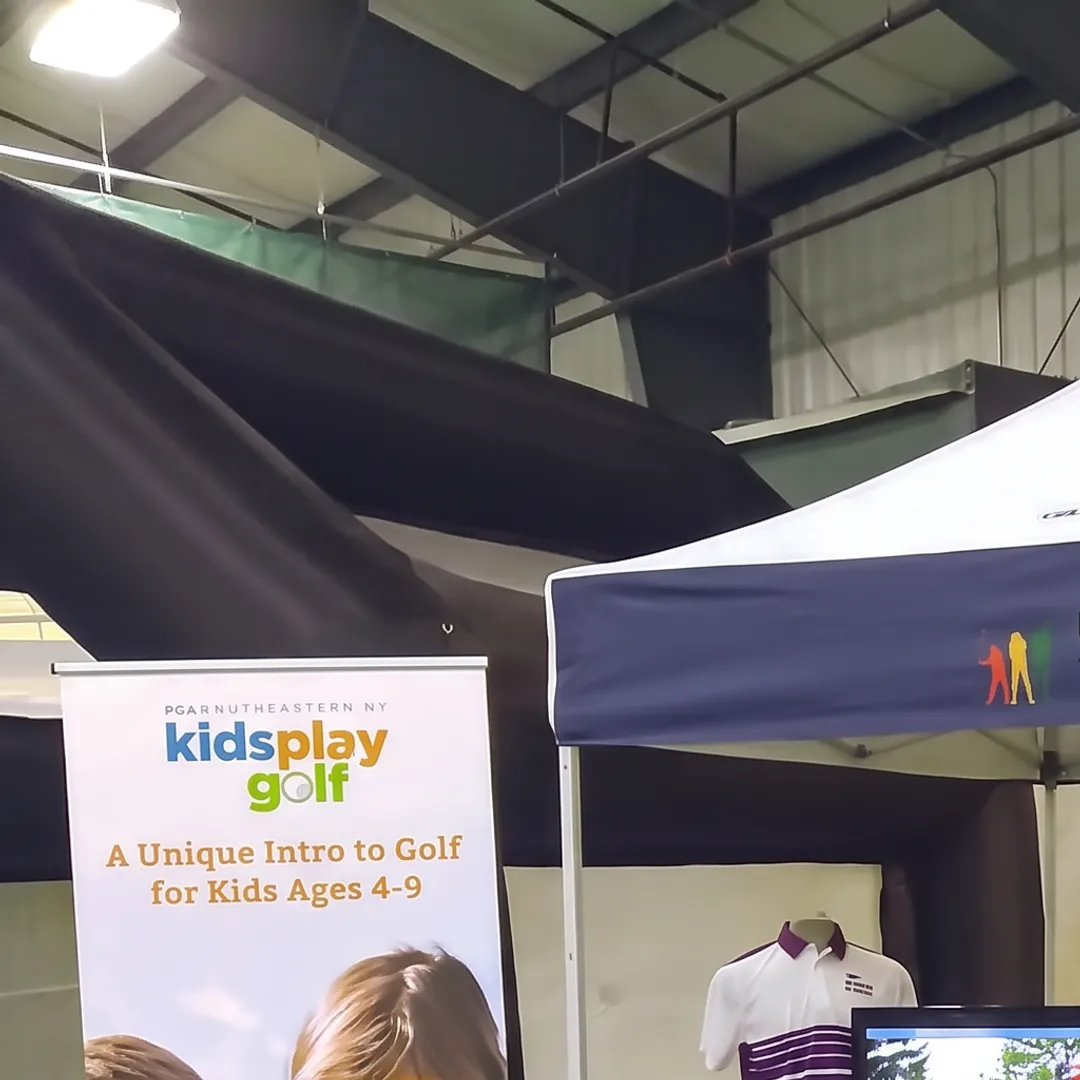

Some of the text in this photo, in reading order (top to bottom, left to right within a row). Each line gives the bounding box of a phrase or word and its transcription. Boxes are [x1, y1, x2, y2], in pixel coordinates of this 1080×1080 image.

[364, 702, 388, 713] NY
[165, 720, 388, 771] kidsplay
[247, 763, 349, 812] golf
[106, 835, 463, 871] A Unique Intro to Golf
[151, 875, 422, 908] for Kids Ages 4-9
